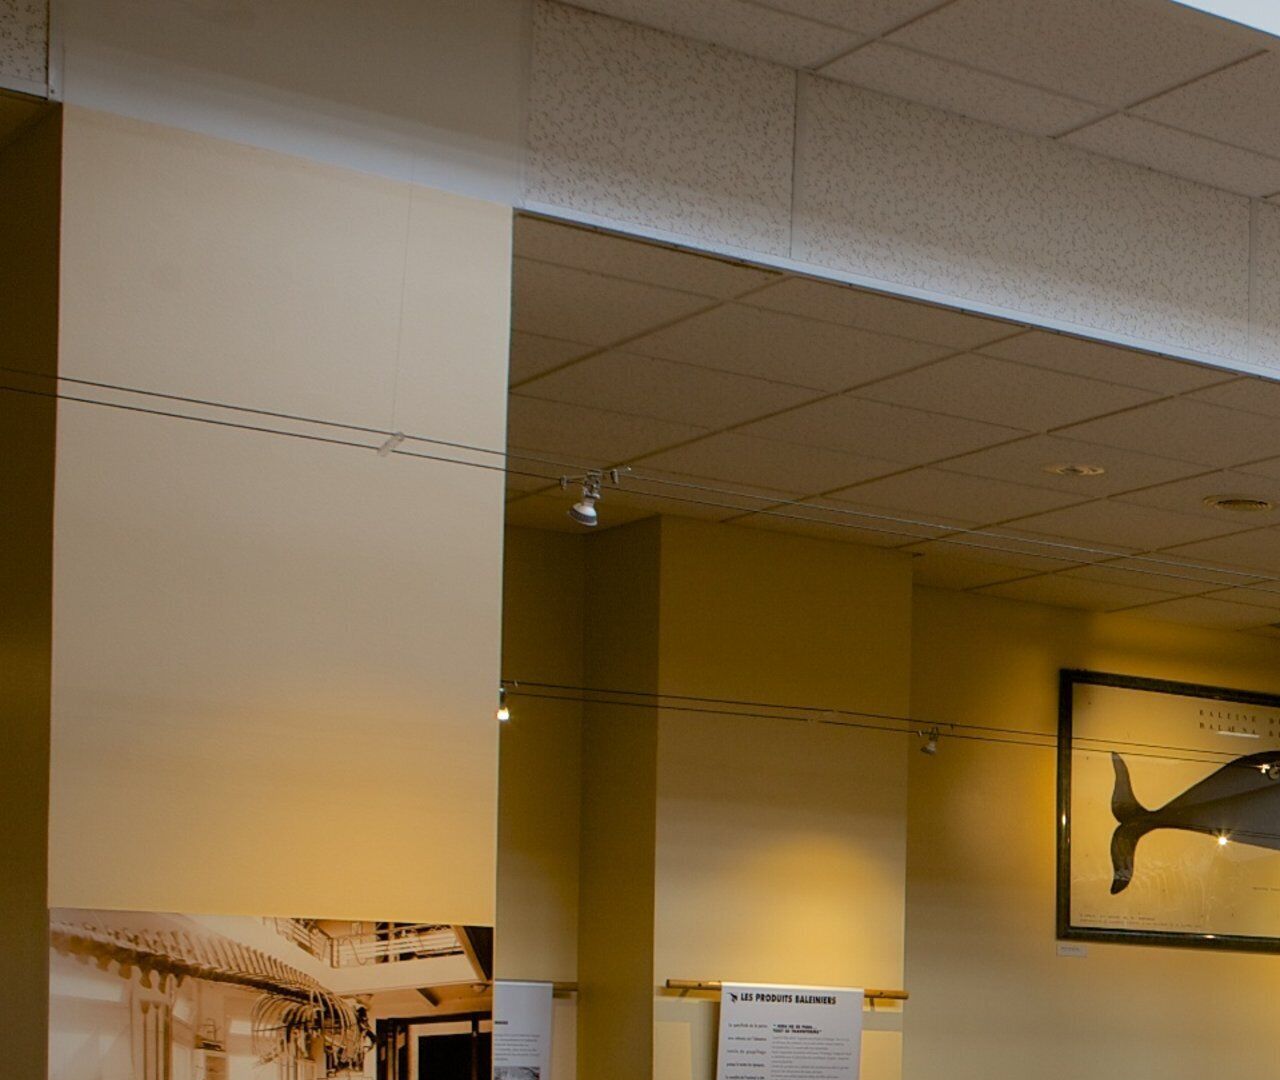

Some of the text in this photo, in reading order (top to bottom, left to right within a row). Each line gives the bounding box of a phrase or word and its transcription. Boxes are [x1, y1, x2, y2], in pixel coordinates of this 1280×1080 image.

[740, 992, 837, 1005] LES PRODUITS BALEINIERS
